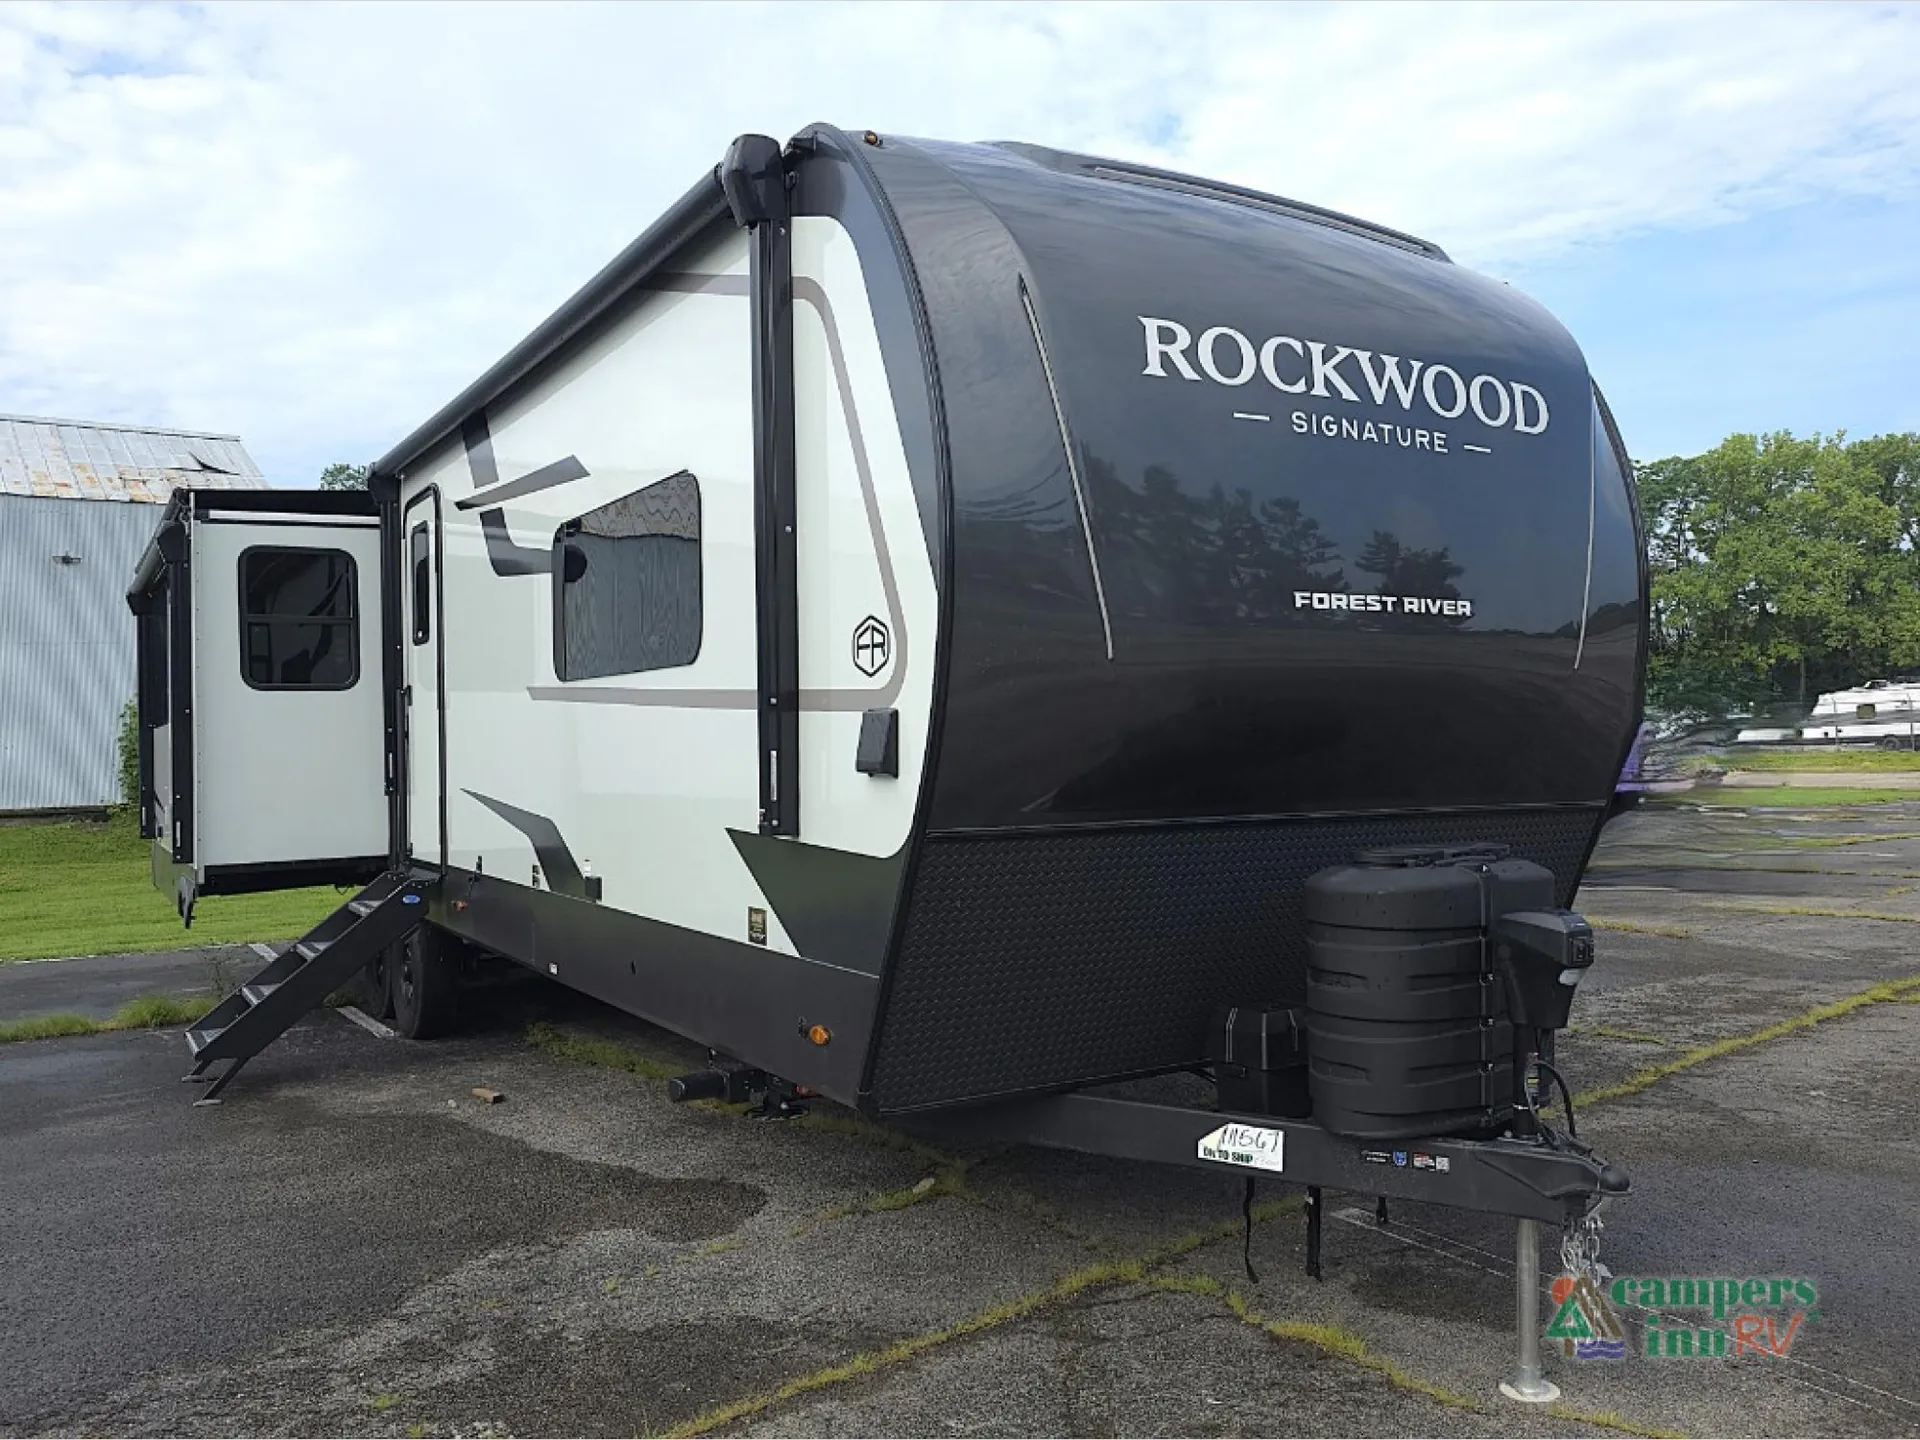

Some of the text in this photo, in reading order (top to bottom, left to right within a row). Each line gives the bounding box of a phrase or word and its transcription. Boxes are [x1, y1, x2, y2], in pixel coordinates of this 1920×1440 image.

[1137, 315, 1550, 435] ROCKWOOD
[1291, 410, 1449, 454] SIGNATURE
[1293, 591, 1472, 616] FOREST RIVER
